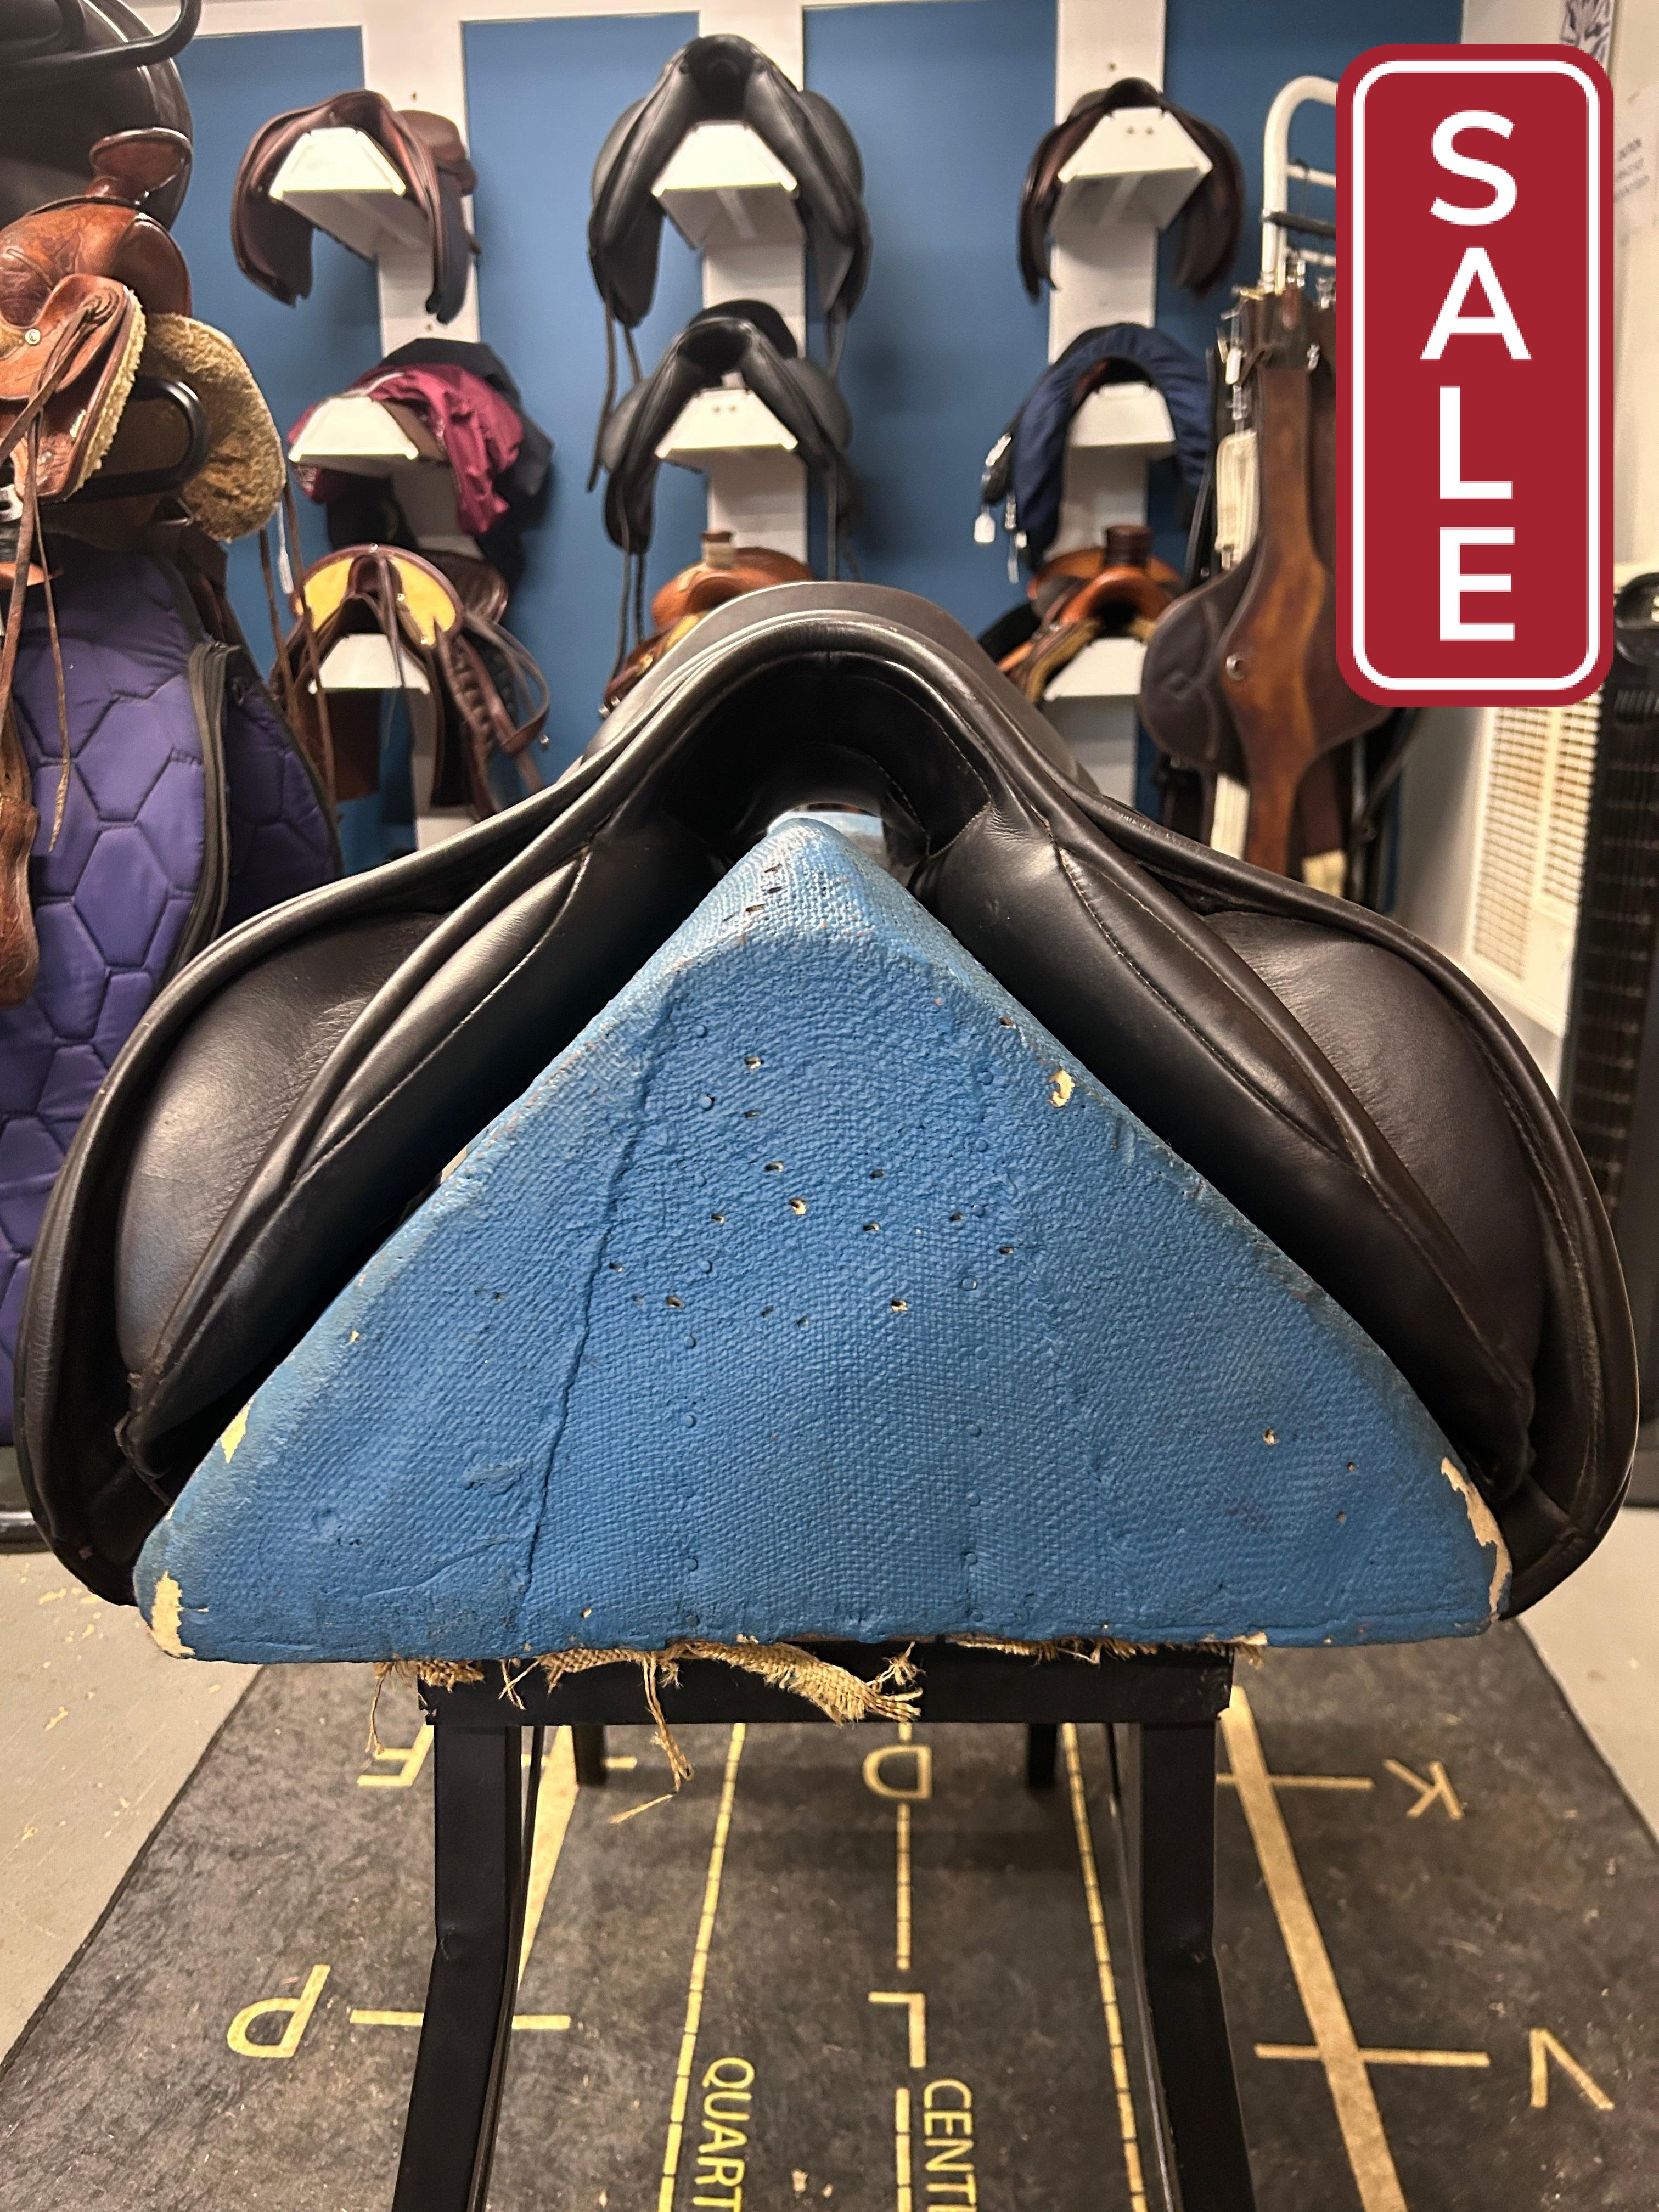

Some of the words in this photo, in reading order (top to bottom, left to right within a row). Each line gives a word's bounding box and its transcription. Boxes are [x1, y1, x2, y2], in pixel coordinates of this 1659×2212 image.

[862, 1744, 932, 1800] D
[1382, 1758, 1465, 1821] K
[227, 1965, 331, 2059] P
[867, 1991, 926, 2069] L
[691, 2057, 755, 2212] QUART
[923, 2078, 978, 2212] CENT
